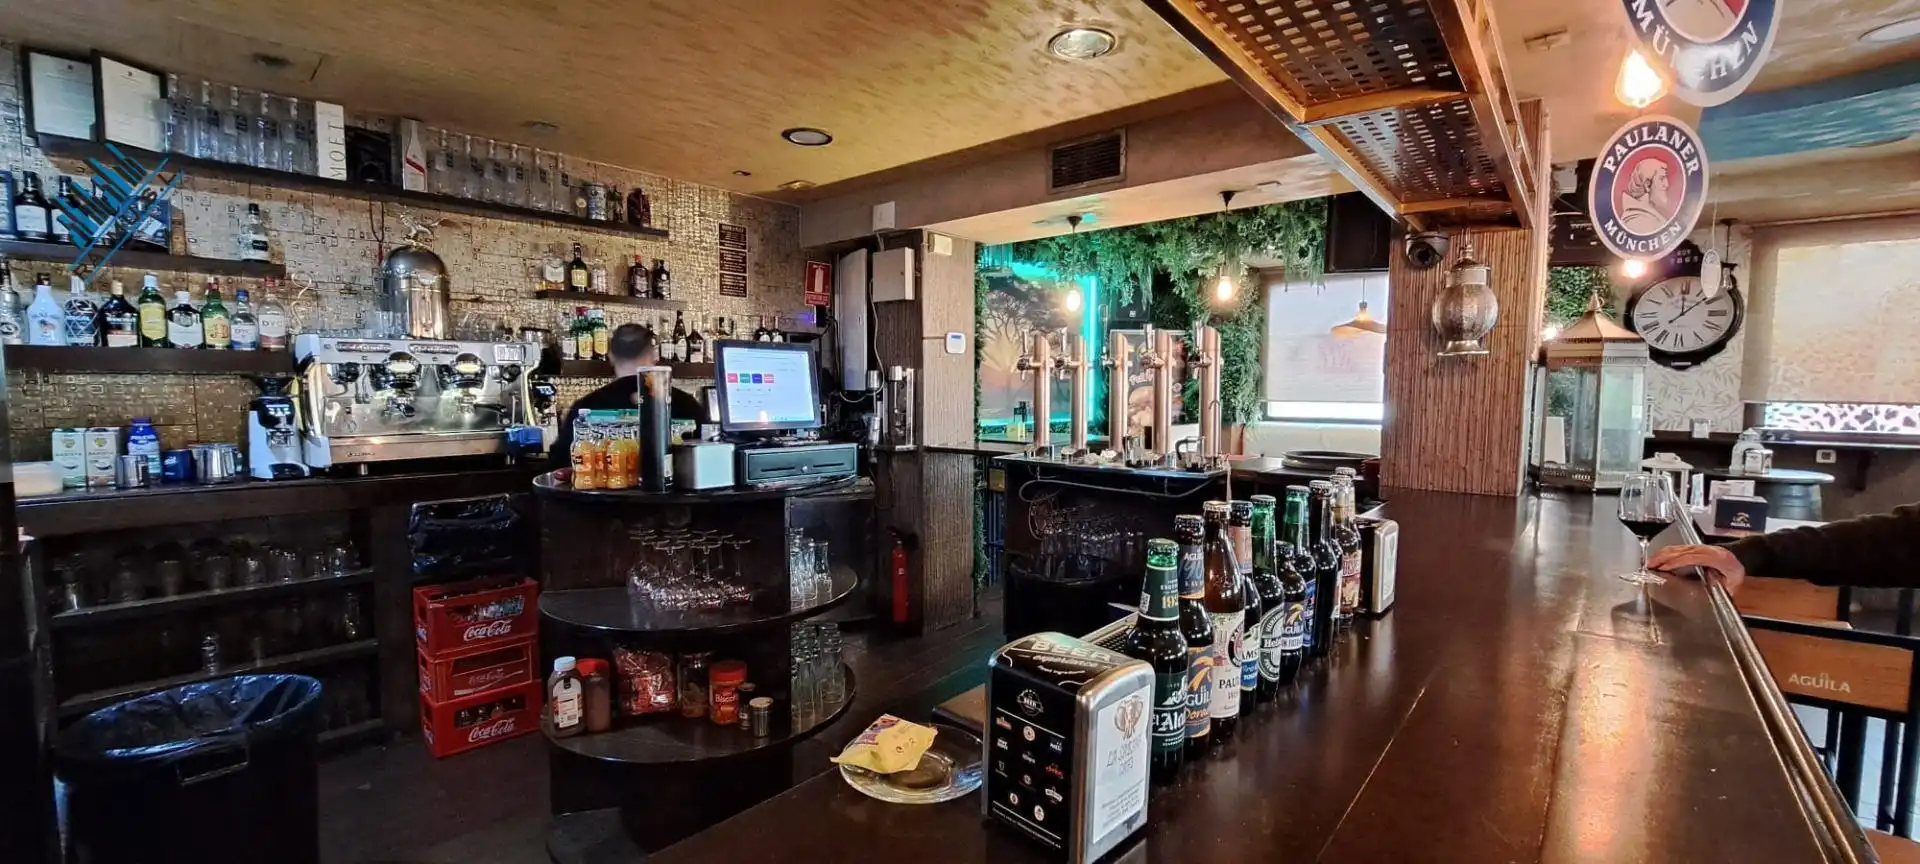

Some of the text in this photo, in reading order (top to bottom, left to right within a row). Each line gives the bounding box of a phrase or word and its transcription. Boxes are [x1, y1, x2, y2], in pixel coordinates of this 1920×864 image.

[1632, 0, 1758, 80] MÜHEN
[1603, 125, 1700, 176] PAULANER
[1604, 218, 1682, 252] MÜNCHEN
[1031, 640, 1111, 662] BEER
